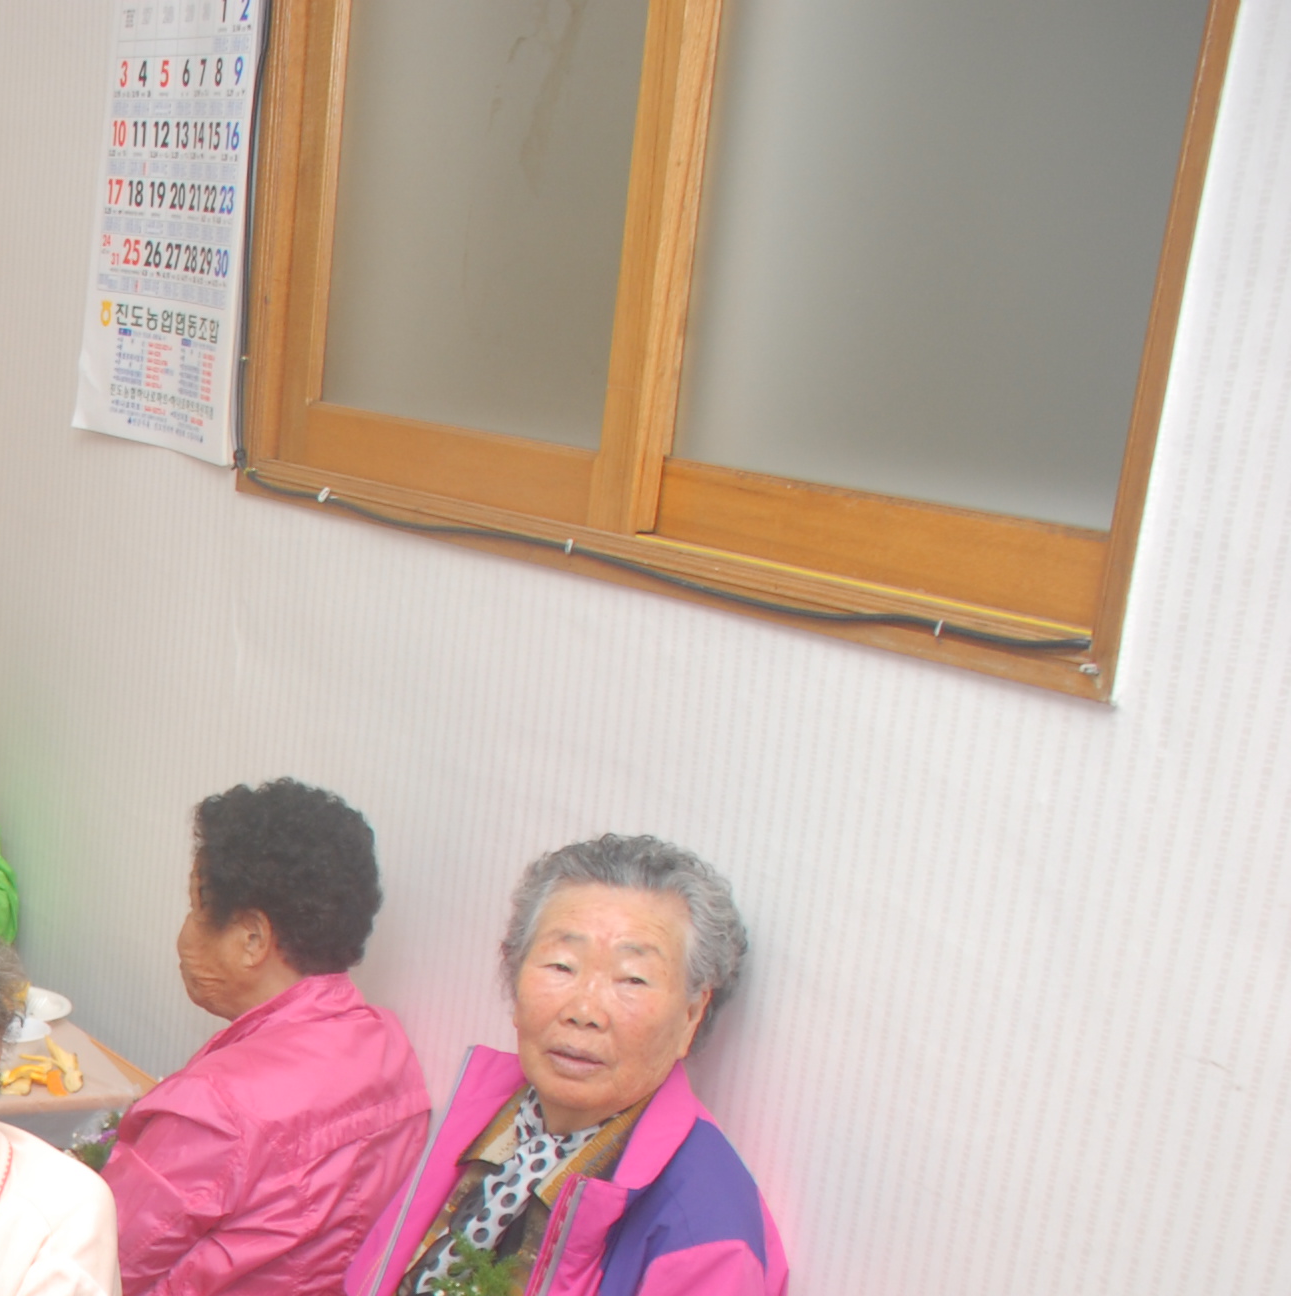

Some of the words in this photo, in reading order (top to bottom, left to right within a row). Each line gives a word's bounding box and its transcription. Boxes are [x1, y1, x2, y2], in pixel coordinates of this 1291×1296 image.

[239, 0, 251, 21] 2
[120, 60, 128, 87] 3
[138, 60, 147, 87] 4
[160, 60, 170, 87] 5
[182, 59, 190, 87] 6
[199, 58, 207, 86] 7
[214, 57, 223, 86] 8
[234, 56, 244, 85] 9
[113, 120, 127, 147] 10
[133, 121, 147, 147] 11
[154, 121, 170, 148] 12
[175, 121, 189, 149] 13
[193, 121, 205, 149] 14
[209, 121, 221, 150] 15
[226, 121, 240, 150] 16
[108, 178, 124, 205] 17
[128, 180, 144, 207] 18
[149, 181, 166, 208] 19
[169, 182, 186, 210] 20
[188, 183, 201, 212] 21
[203, 184, 217, 213] 22
[219, 185, 235, 215] 23
[102, 234, 111, 247] 24
[123, 238, 140, 266] 25
[144, 240, 162, 268] 26
[165, 242, 182, 270] 27
[184, 245, 198, 273] 28
[199, 247, 213, 275] 29
[214, 249, 229, 278] 30
[116, 303, 219, 344] 진도농업협동조합
